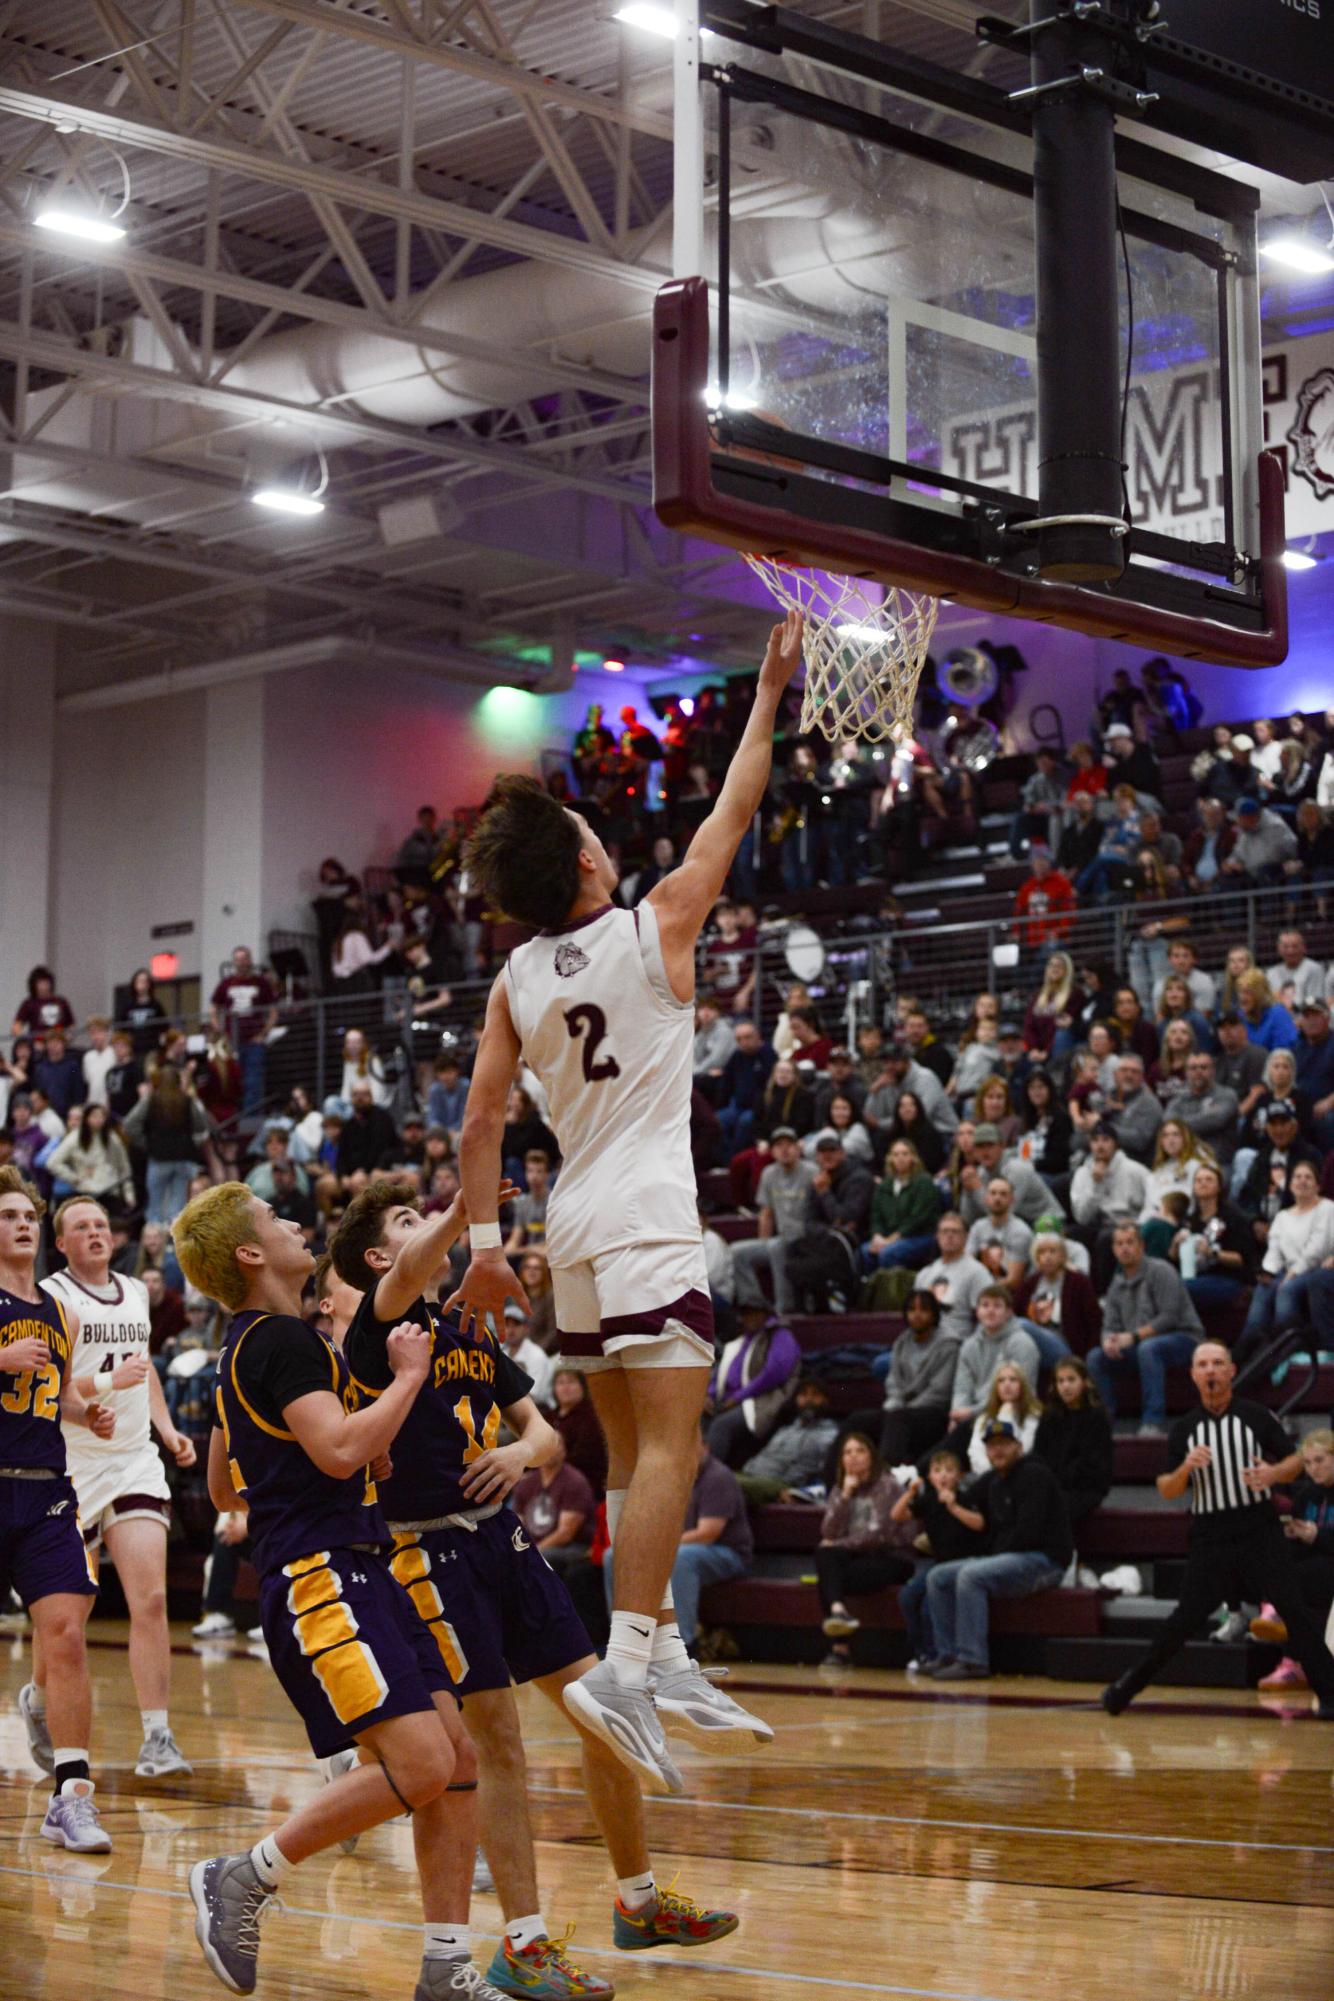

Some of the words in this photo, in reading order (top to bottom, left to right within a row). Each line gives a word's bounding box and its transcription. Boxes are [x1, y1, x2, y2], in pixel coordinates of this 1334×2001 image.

[563, 1003, 621, 1084] 2
[1, 1362, 61, 1422] 32
[99, 1352, 134, 1374] 4
